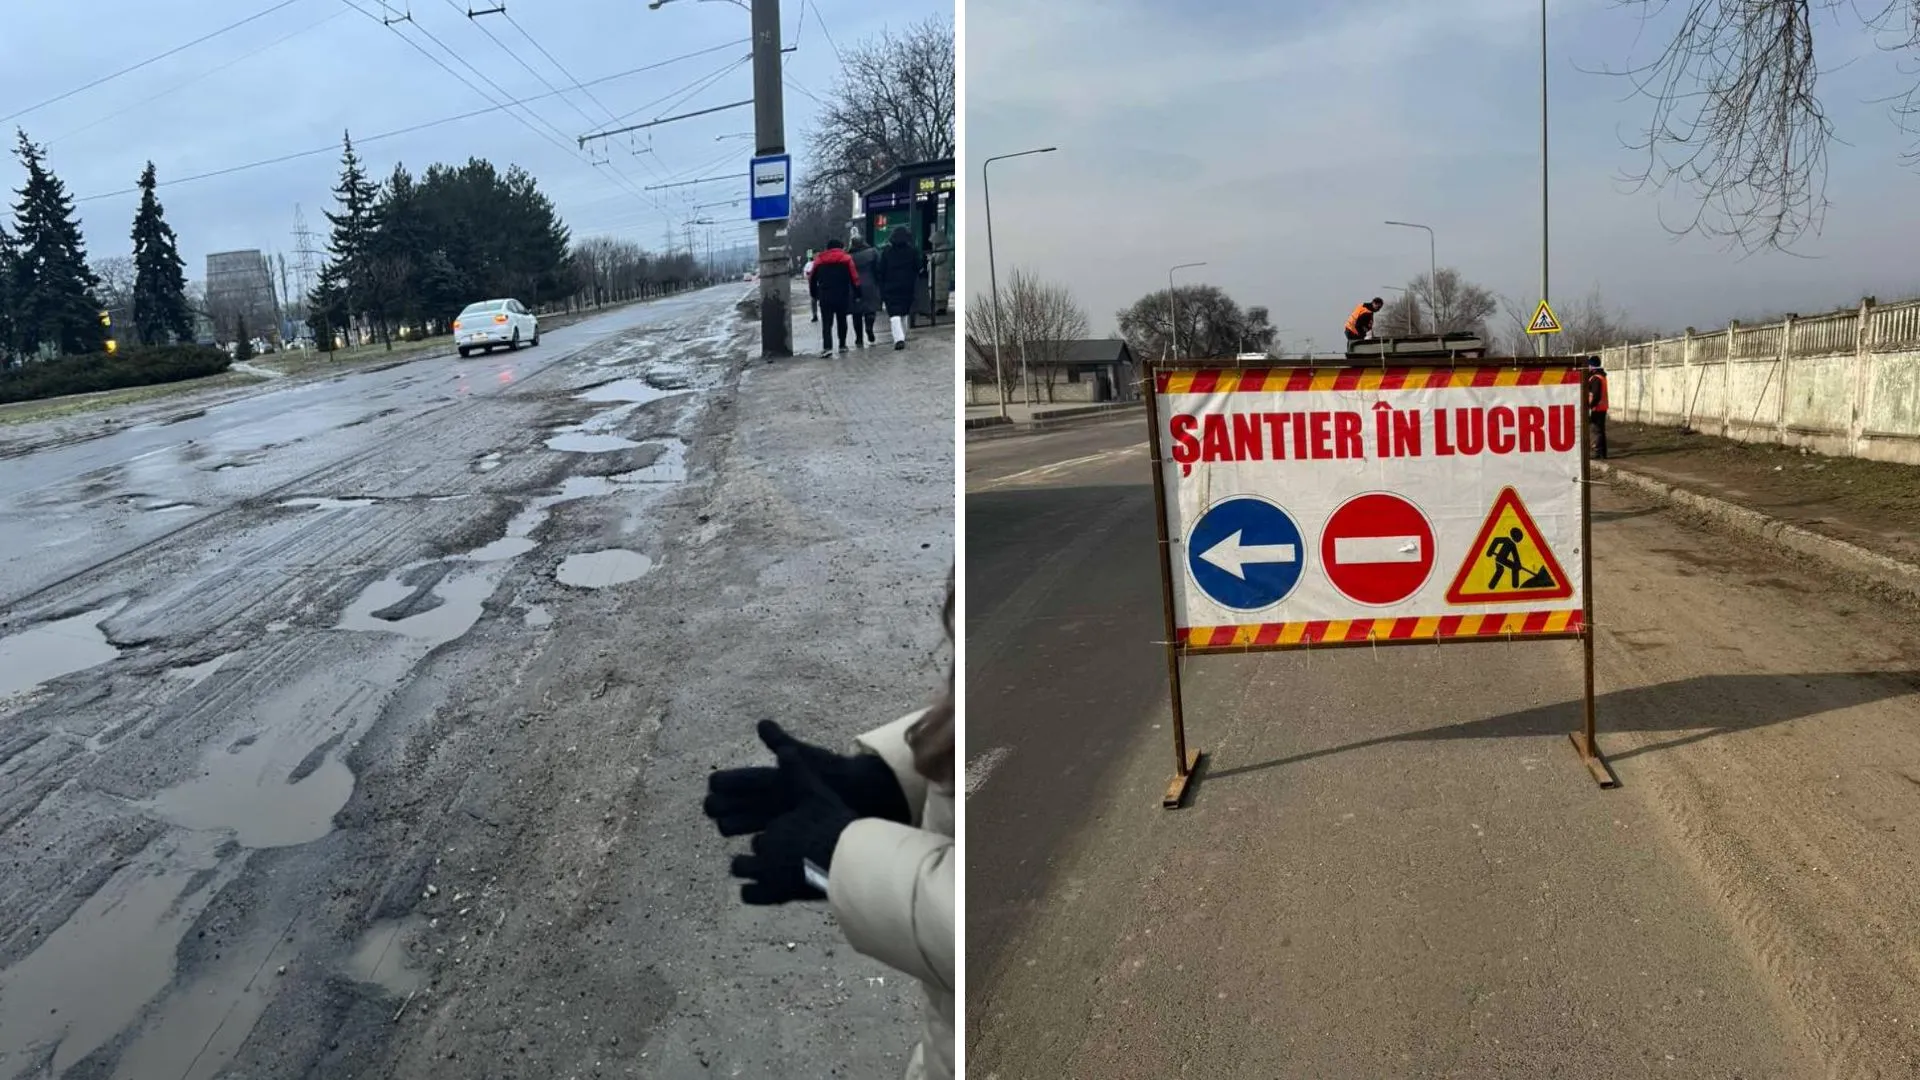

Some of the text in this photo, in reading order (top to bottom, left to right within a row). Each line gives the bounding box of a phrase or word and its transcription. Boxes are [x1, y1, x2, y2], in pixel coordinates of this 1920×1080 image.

[1170, 400, 1576, 478] ȘANTIER ÎN LUCRU
